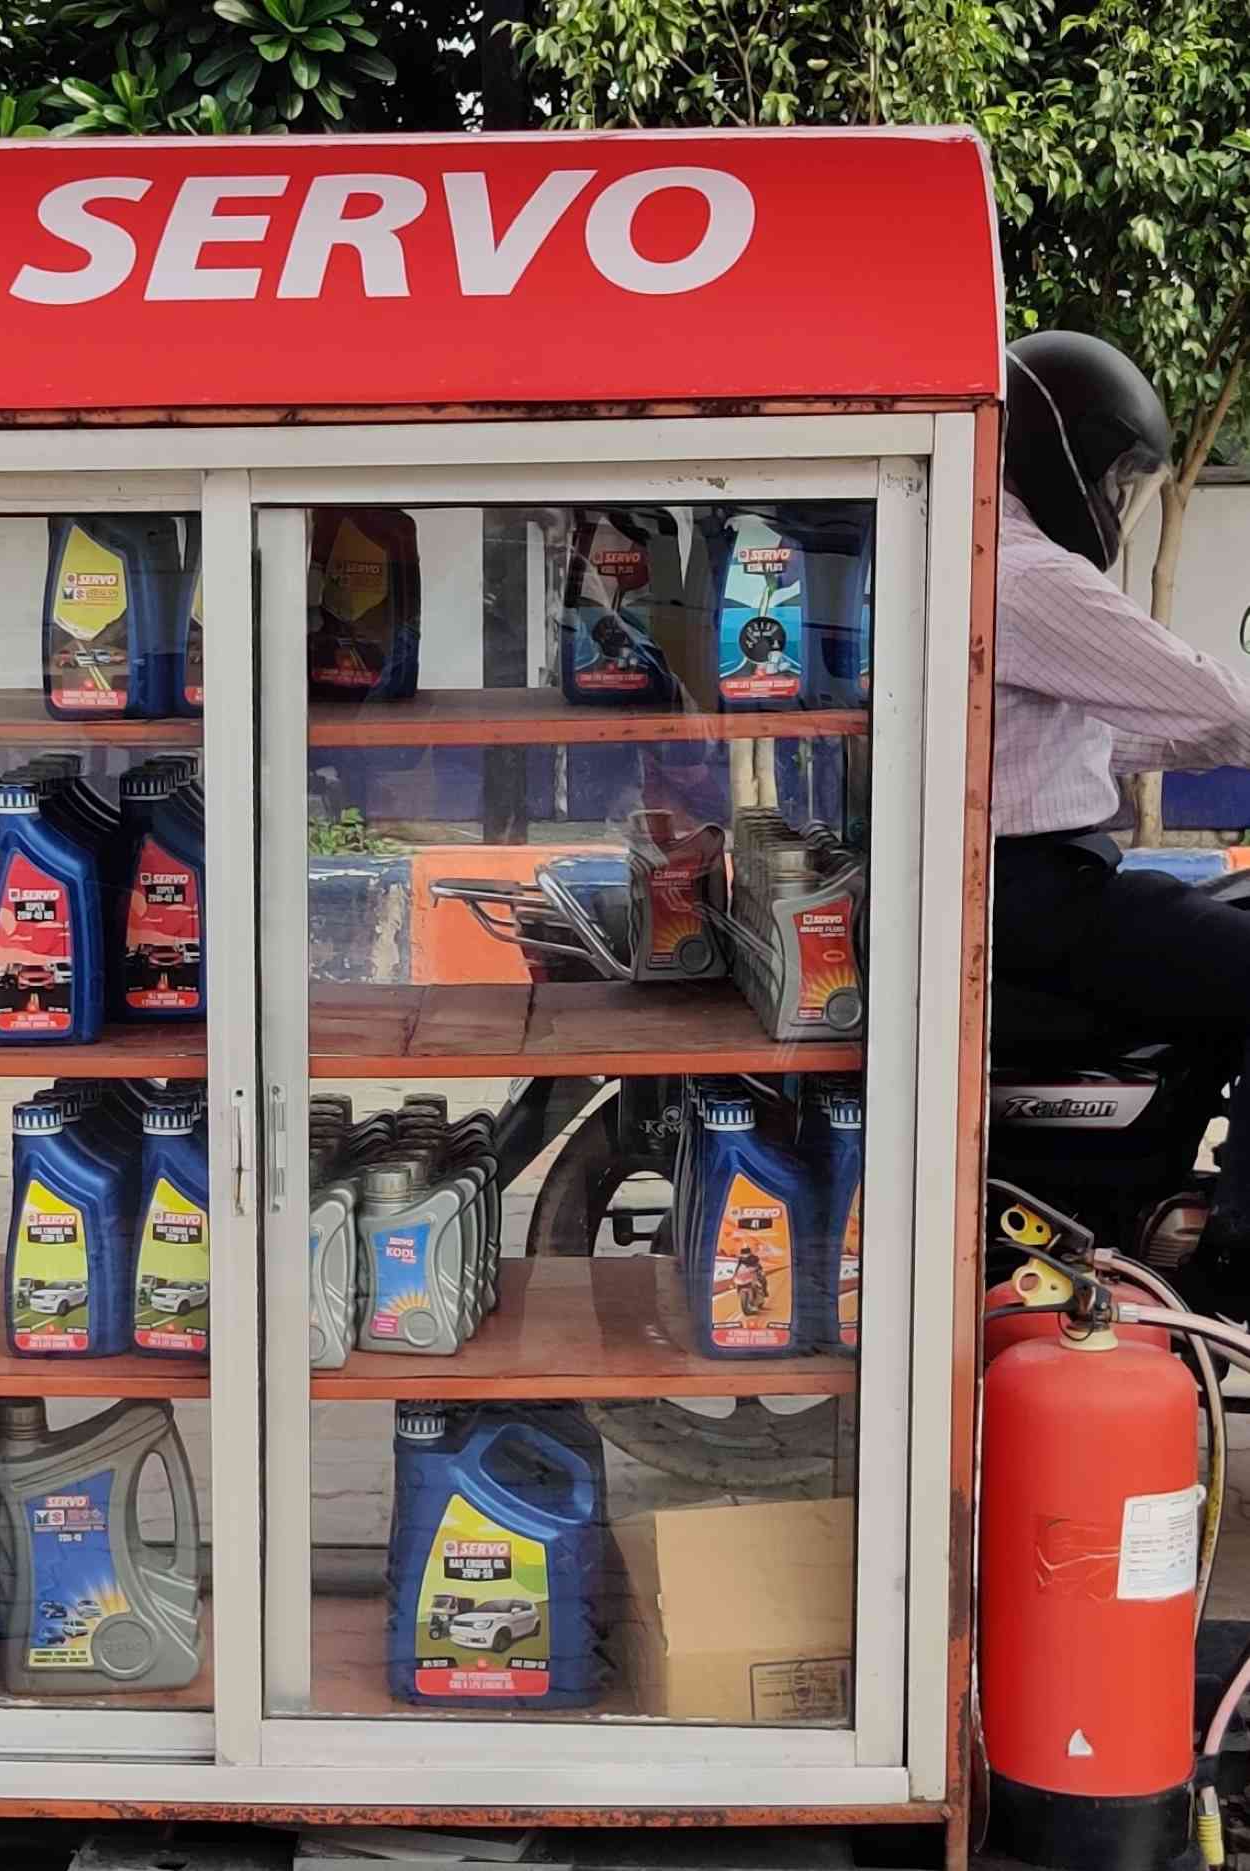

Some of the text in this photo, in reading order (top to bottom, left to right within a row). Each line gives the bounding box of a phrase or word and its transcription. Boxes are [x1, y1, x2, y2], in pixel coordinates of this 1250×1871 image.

[10, 165, 756, 306] SERVO
[604, 552, 639, 564] SERVO
[750, 548, 791, 561] SERVO
[77, 574, 117, 585] SERVO
[153, 873, 189, 885] SERVO
[20, 889, 60, 901] SERVO
[813, 915, 843, 925] SERVO
[1005, 1097, 1119, 1118] Radeon
[743, 1207, 781, 1218] SERVO
[38, 1214, 75, 1226] SERVO
[165, 1212, 201, 1226] SERVO
[389, 1237, 414, 1246] SERVO
[46, 1496, 86, 1508] SERVO
[461, 1542, 508, 1555] SERVO
